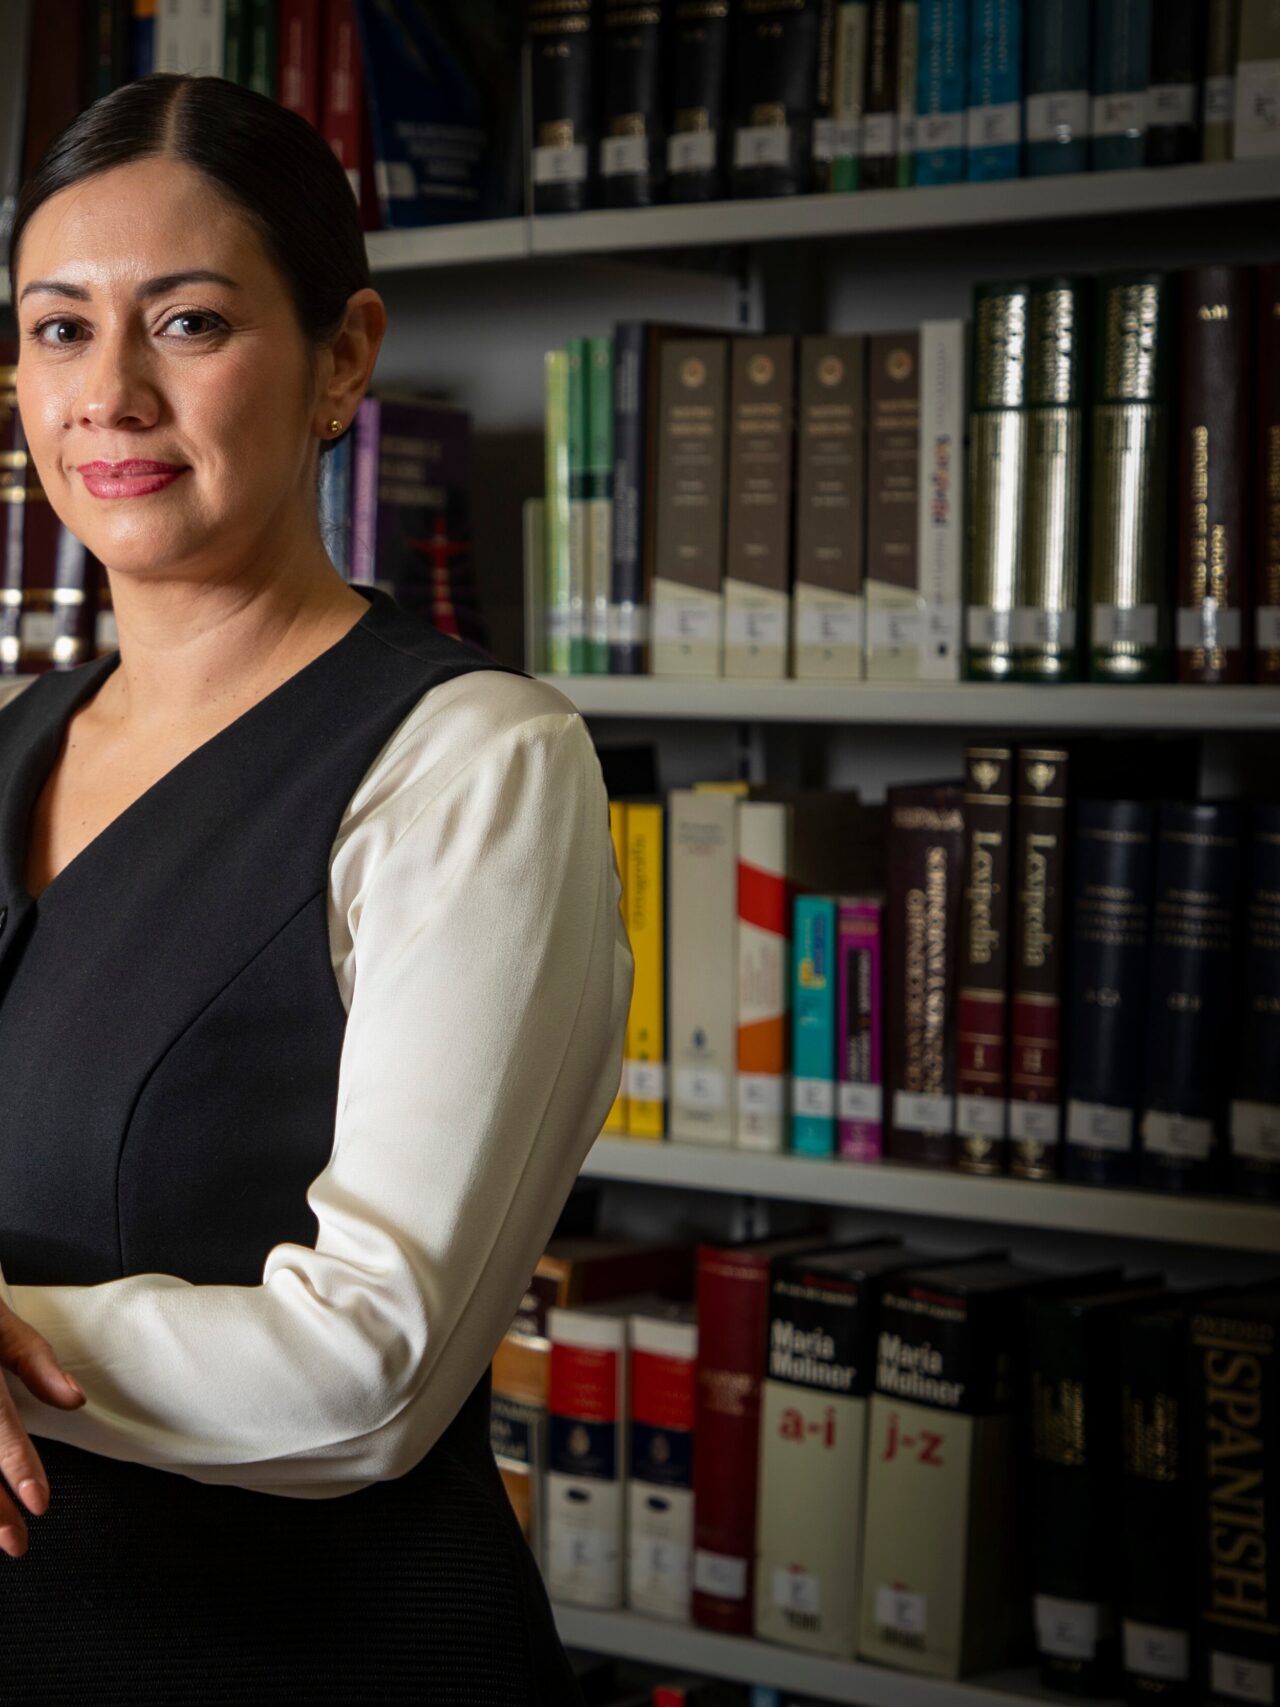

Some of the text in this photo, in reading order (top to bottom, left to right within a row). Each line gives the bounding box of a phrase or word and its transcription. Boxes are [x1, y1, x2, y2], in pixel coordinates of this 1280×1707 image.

[772, 1318, 835, 1360] María
[878, 1331, 943, 1375] María
[770, 1353, 856, 1391] Moliner
[876, 1363, 965, 1407] Moliner
[779, 1406, 835, 1448] a-i
[882, 1411, 945, 1465] j-z
[1203, 1350, 1268, 1620] SPANISH
